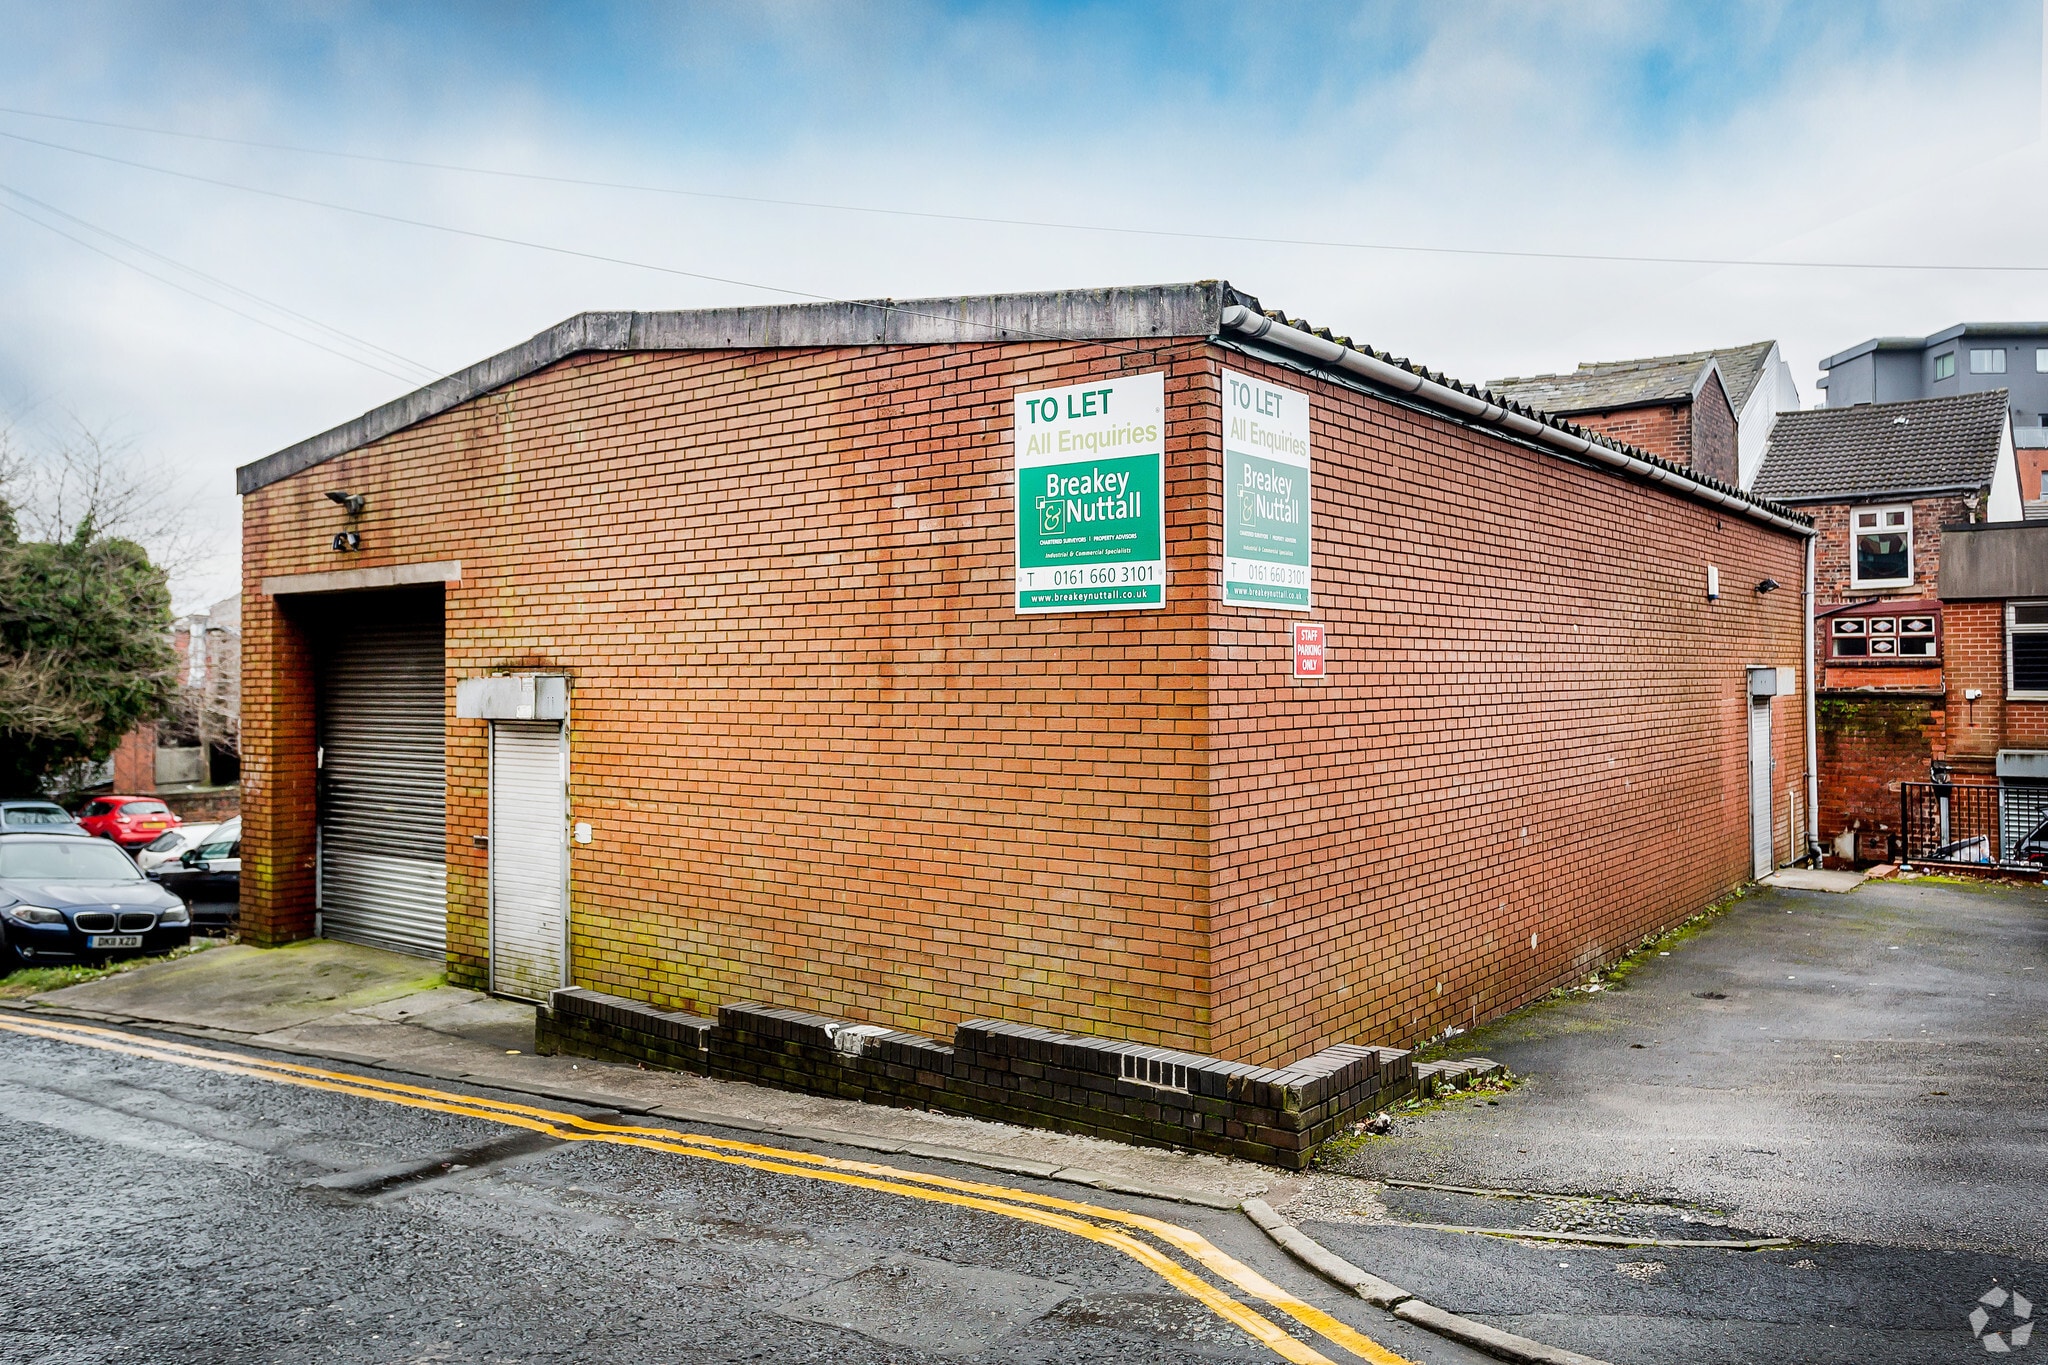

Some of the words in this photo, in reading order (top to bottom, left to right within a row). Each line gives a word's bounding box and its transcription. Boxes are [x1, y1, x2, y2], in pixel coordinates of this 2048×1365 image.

[1026, 396, 1058, 424] TO
[1068, 388, 1113, 419] LET
[1230, 380, 1250, 409] TO
[1256, 388, 1282, 418] LET
[1026, 432, 1050, 456] All
[1058, 422, 1157, 454] Enquiries
[1231, 416, 1246, 441] All
[1250, 422, 1306, 456] Enquiries
[1047, 467, 1130, 500] Breakey
[1244, 463, 1292, 503] Breakey
[1067, 492, 1141, 523] Nuttall
[1256, 494, 1298, 524] Nuttall
[1027, 572, 1034, 587] T
[1054, 569, 1083, 586] 0161
[1090, 567, 1116, 584] 660
[1121, 566, 1153, 582] 3101
[1231, 562, 1236, 578] T
[1249, 564, 1267, 580] 0161
[1271, 567, 1285, 583] 660
[1288, 569, 1304, 585] 3101
[1031, 589, 1147, 603] www.breakeynuttall.co.uk
[1298, 644, 1321, 656] PARKING
[1301, 630, 1317, 641] STAFF
[1302, 660, 1317, 671] ONLY
